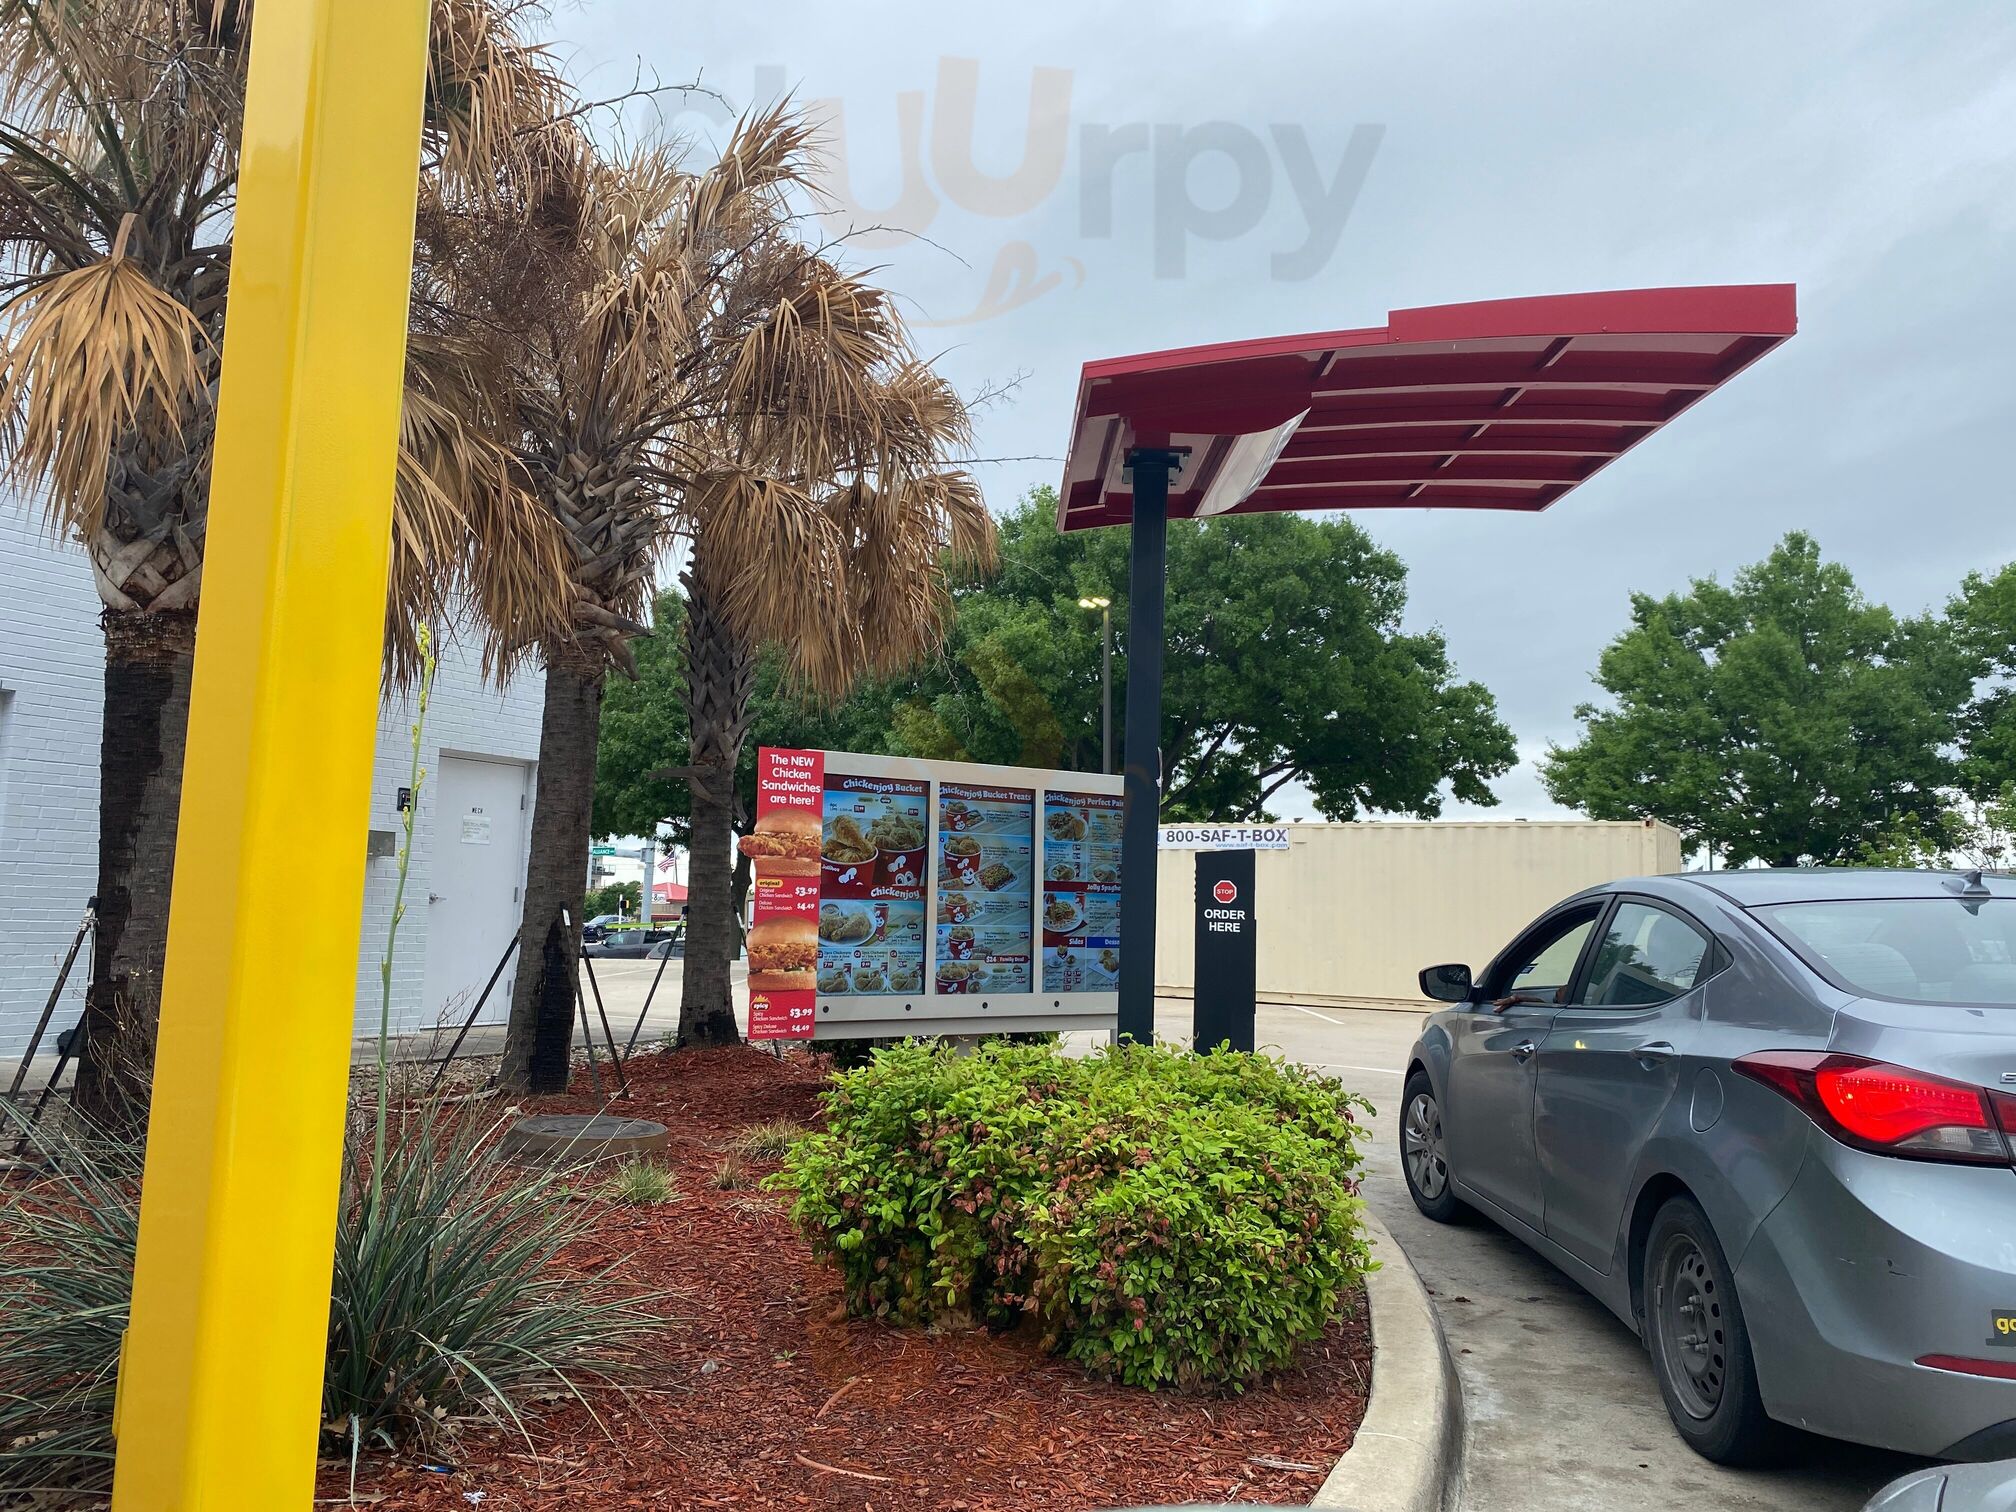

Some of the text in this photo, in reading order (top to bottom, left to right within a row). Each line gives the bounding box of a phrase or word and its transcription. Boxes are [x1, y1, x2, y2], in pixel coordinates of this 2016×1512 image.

[770, 754, 815, 767] The NEW
[772, 767, 811, 780] Chicken
[762, 780, 821, 793] Sandwiches
[843, 778, 923, 794] Chickenjoy Bucket
[770, 794, 815, 806] are here!
[983, 790, 1008, 799] Bucket
[1008, 792, 1032, 800] Treats
[1044, 794, 1086, 806] Chickenjoy
[1087, 798, 1110, 806] Perfect
[1166, 830, 1288, 842] 800-SAF-T-BOX
[795, 886, 818, 896] $3.99
[870, 886, 920, 900] Chickenjoy
[796, 902, 815, 910] $4.49
[1204, 909, 1246, 920] ORDER
[1209, 922, 1241, 932] HERE
[790, 1008, 812, 1018] $3.99
[792, 1024, 810, 1032] $4.49
